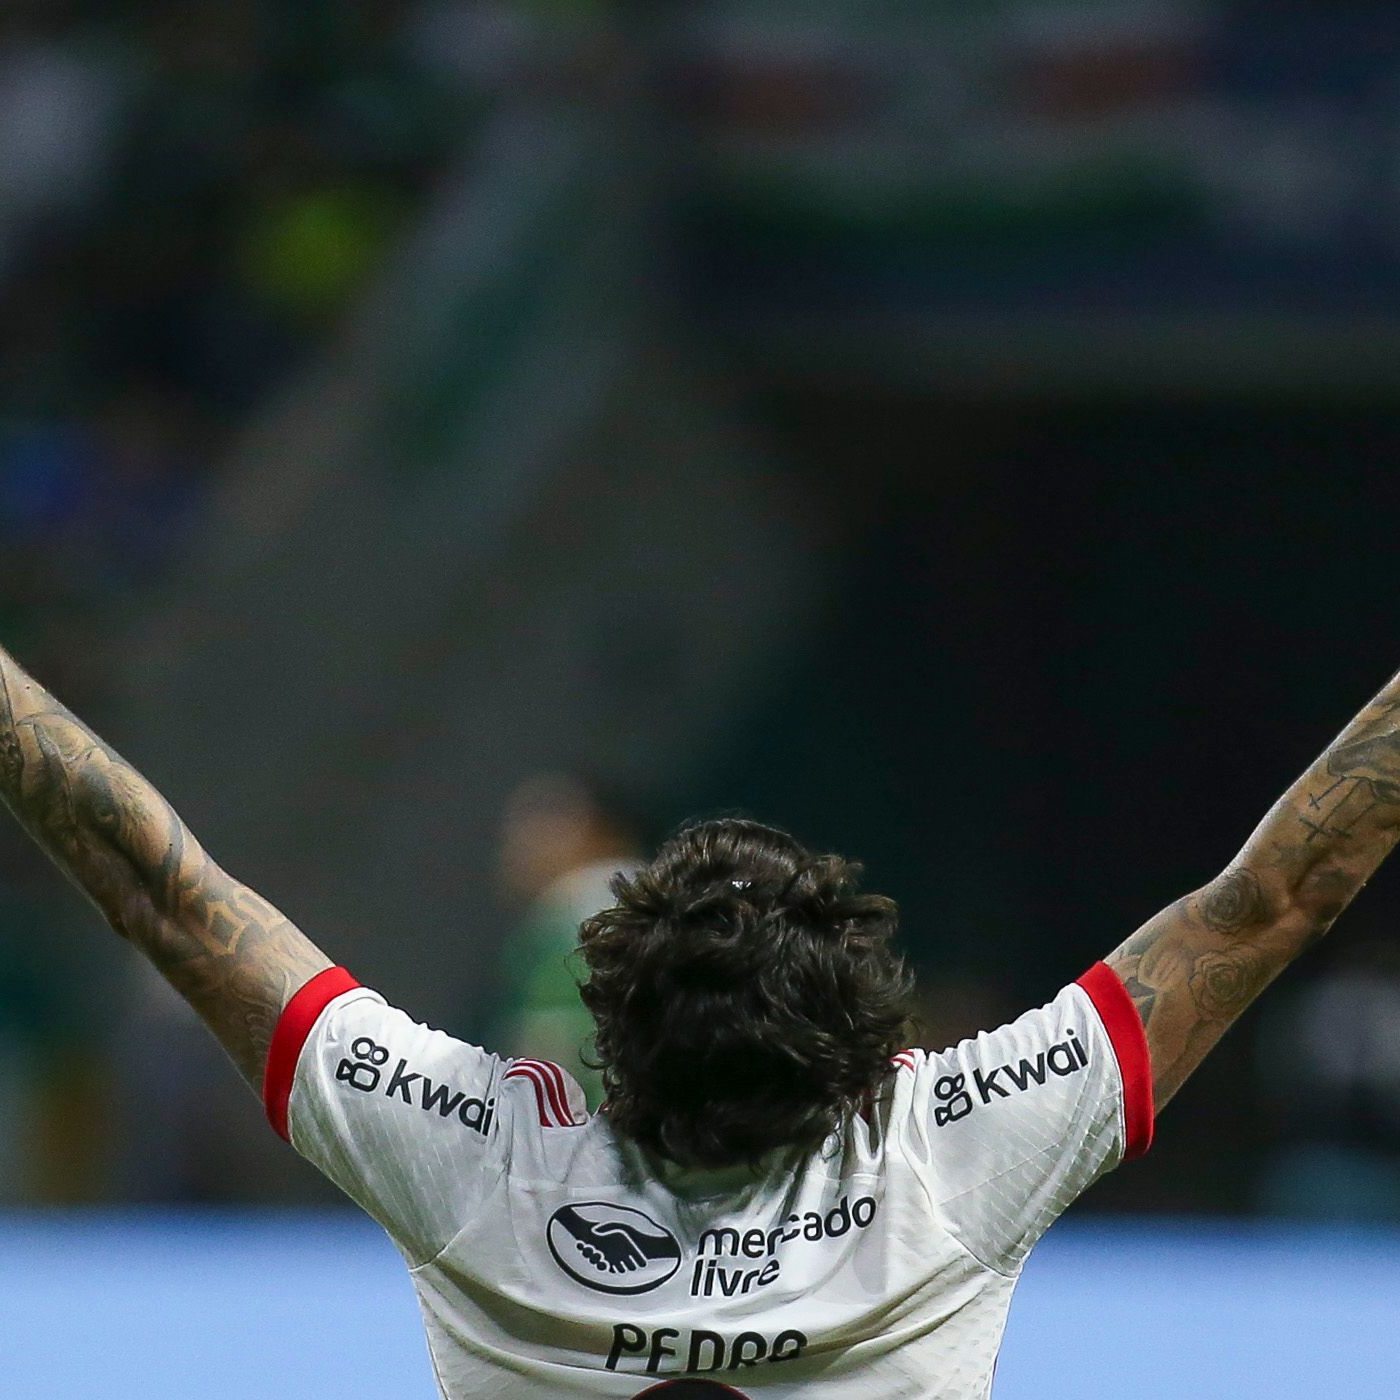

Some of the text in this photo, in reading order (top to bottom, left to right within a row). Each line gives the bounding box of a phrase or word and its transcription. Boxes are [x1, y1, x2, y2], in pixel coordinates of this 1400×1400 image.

[385, 1058, 496, 1137] kwai
[973, 1028, 1089, 1104] kwai
[697, 1195, 877, 1258] mercado
[691, 1258, 780, 1297] livre
